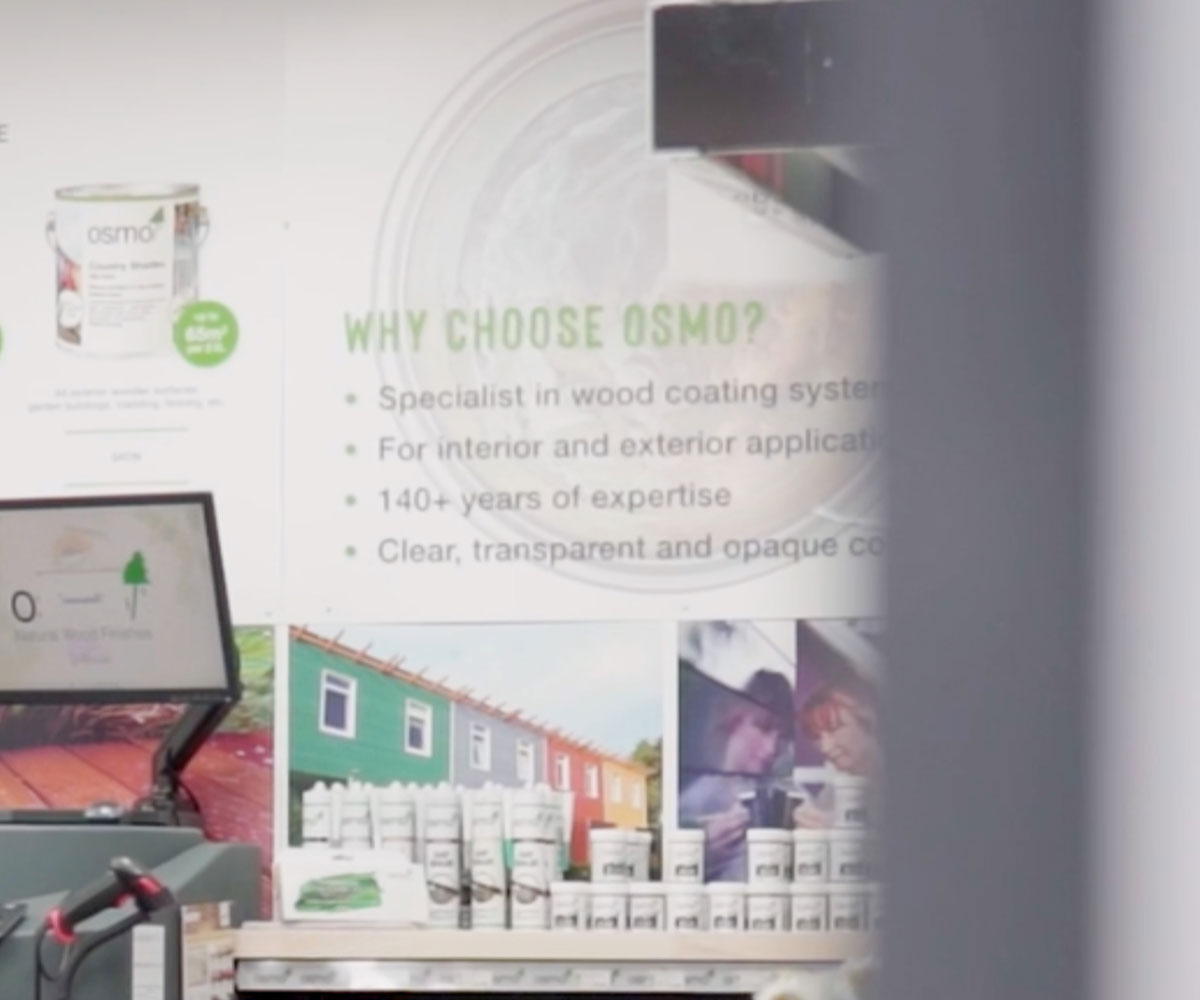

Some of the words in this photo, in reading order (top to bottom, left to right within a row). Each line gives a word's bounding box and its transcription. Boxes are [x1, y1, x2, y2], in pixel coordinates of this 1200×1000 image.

[87, 224, 155, 245] osmo
[343, 308, 428, 354] WHY
[445, 304, 605, 352] CHOOSE
[622, 300, 765, 349] OSMO?
[378, 383, 525, 415] Specialist
[535, 384, 560, 408] in
[571, 381, 654, 407] wood
[664, 379, 778, 409] coating
[378, 436, 428, 462] For
[437, 433, 543, 460] interior
[552, 433, 610, 459] and
[619, 430, 737, 458] exterior
[378, 487, 450, 513] 140+
[460, 491, 542, 517] years
[552, 484, 582, 510] of
[590, 482, 732, 513] expertise
[377, 538, 463, 565] Clear,
[472, 535, 647, 567] transparent
[656, 535, 714, 560] and
[722, 534, 838, 563] opaque
